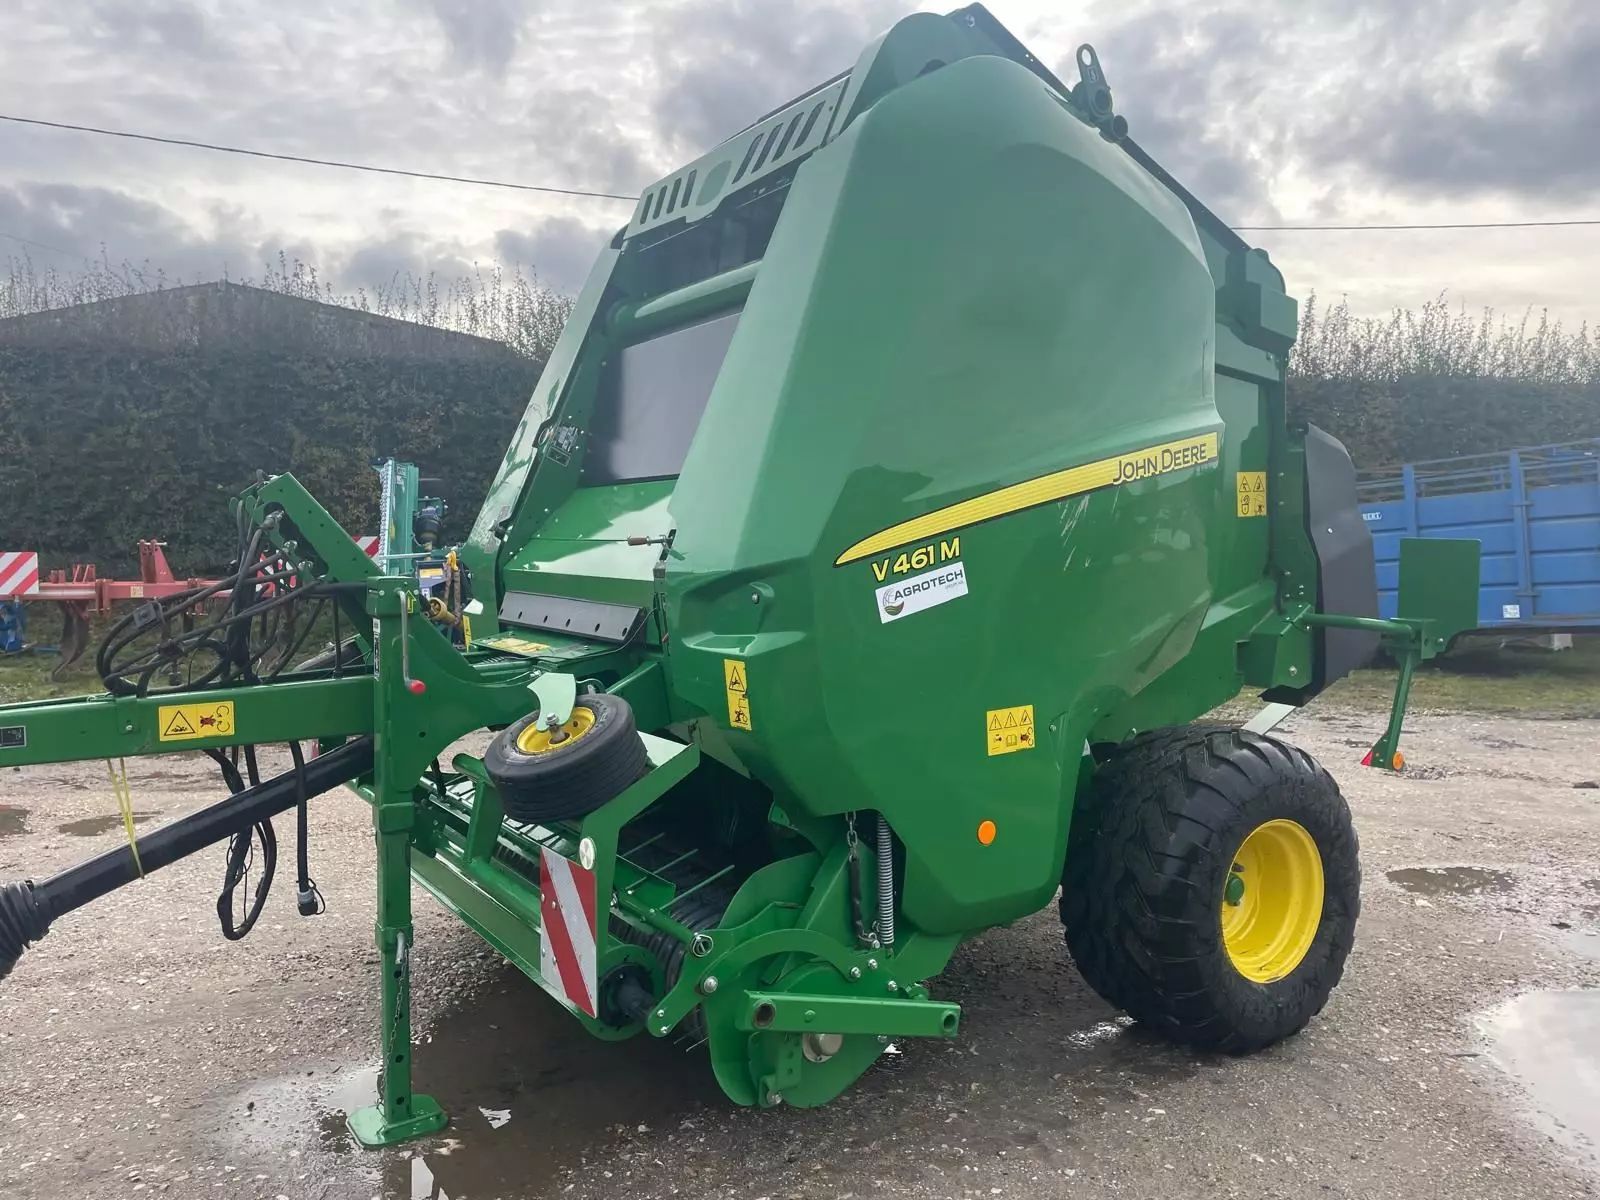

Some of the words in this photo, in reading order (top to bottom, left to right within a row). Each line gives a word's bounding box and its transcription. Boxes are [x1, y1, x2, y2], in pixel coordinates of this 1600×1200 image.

[1112, 456, 1158, 484] JOHN
[1161, 443, 1208, 471] DEERE
[871, 558, 890, 582] V
[893, 544, 935, 575] 461
[940, 537, 961, 562] M
[894, 569, 964, 602] AGROTECH
